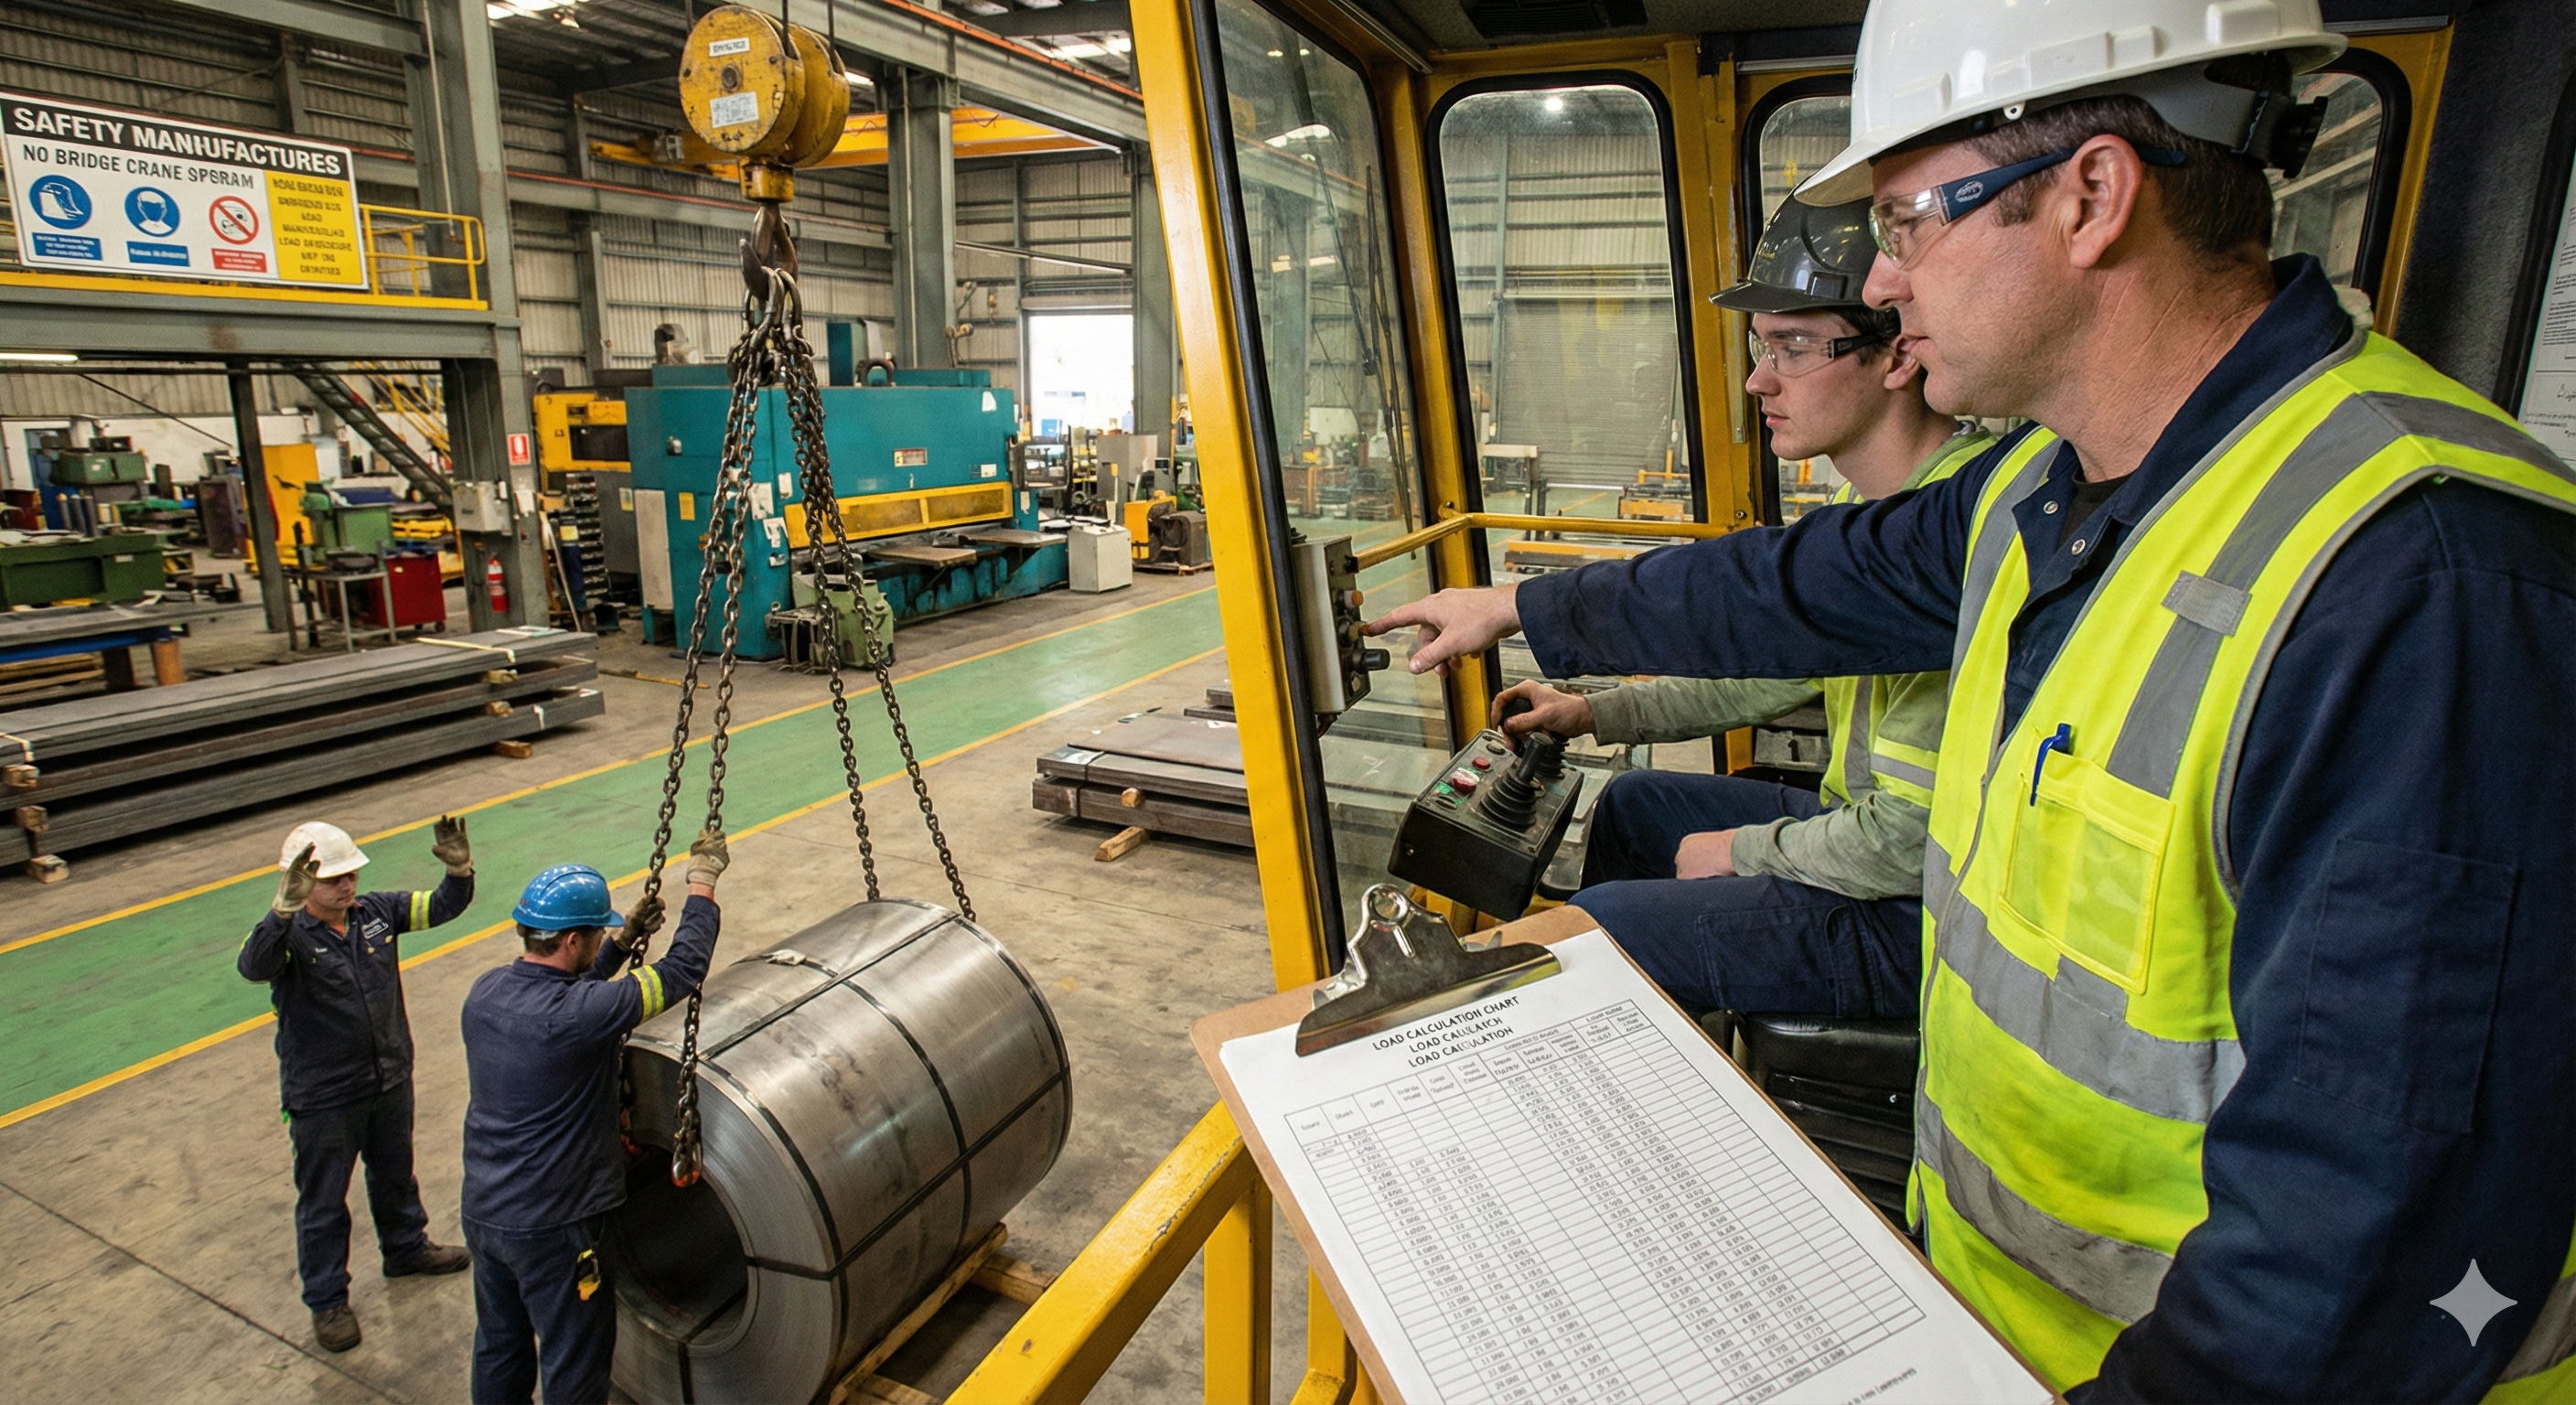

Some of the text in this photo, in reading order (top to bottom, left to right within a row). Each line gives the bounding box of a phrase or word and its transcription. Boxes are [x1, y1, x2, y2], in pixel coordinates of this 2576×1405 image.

[14, 107, 123, 144] SAFETY
[23, 144, 48, 162] NO
[55, 148, 121, 172] BRIDGE
[126, 158, 183, 181] CRANE
[1372, 996, 1519, 1051] LOAD CALCULATION CHART
[1408, 1051, 1441, 1068] LOAD
[1409, 1036, 1441, 1054] LOAD
